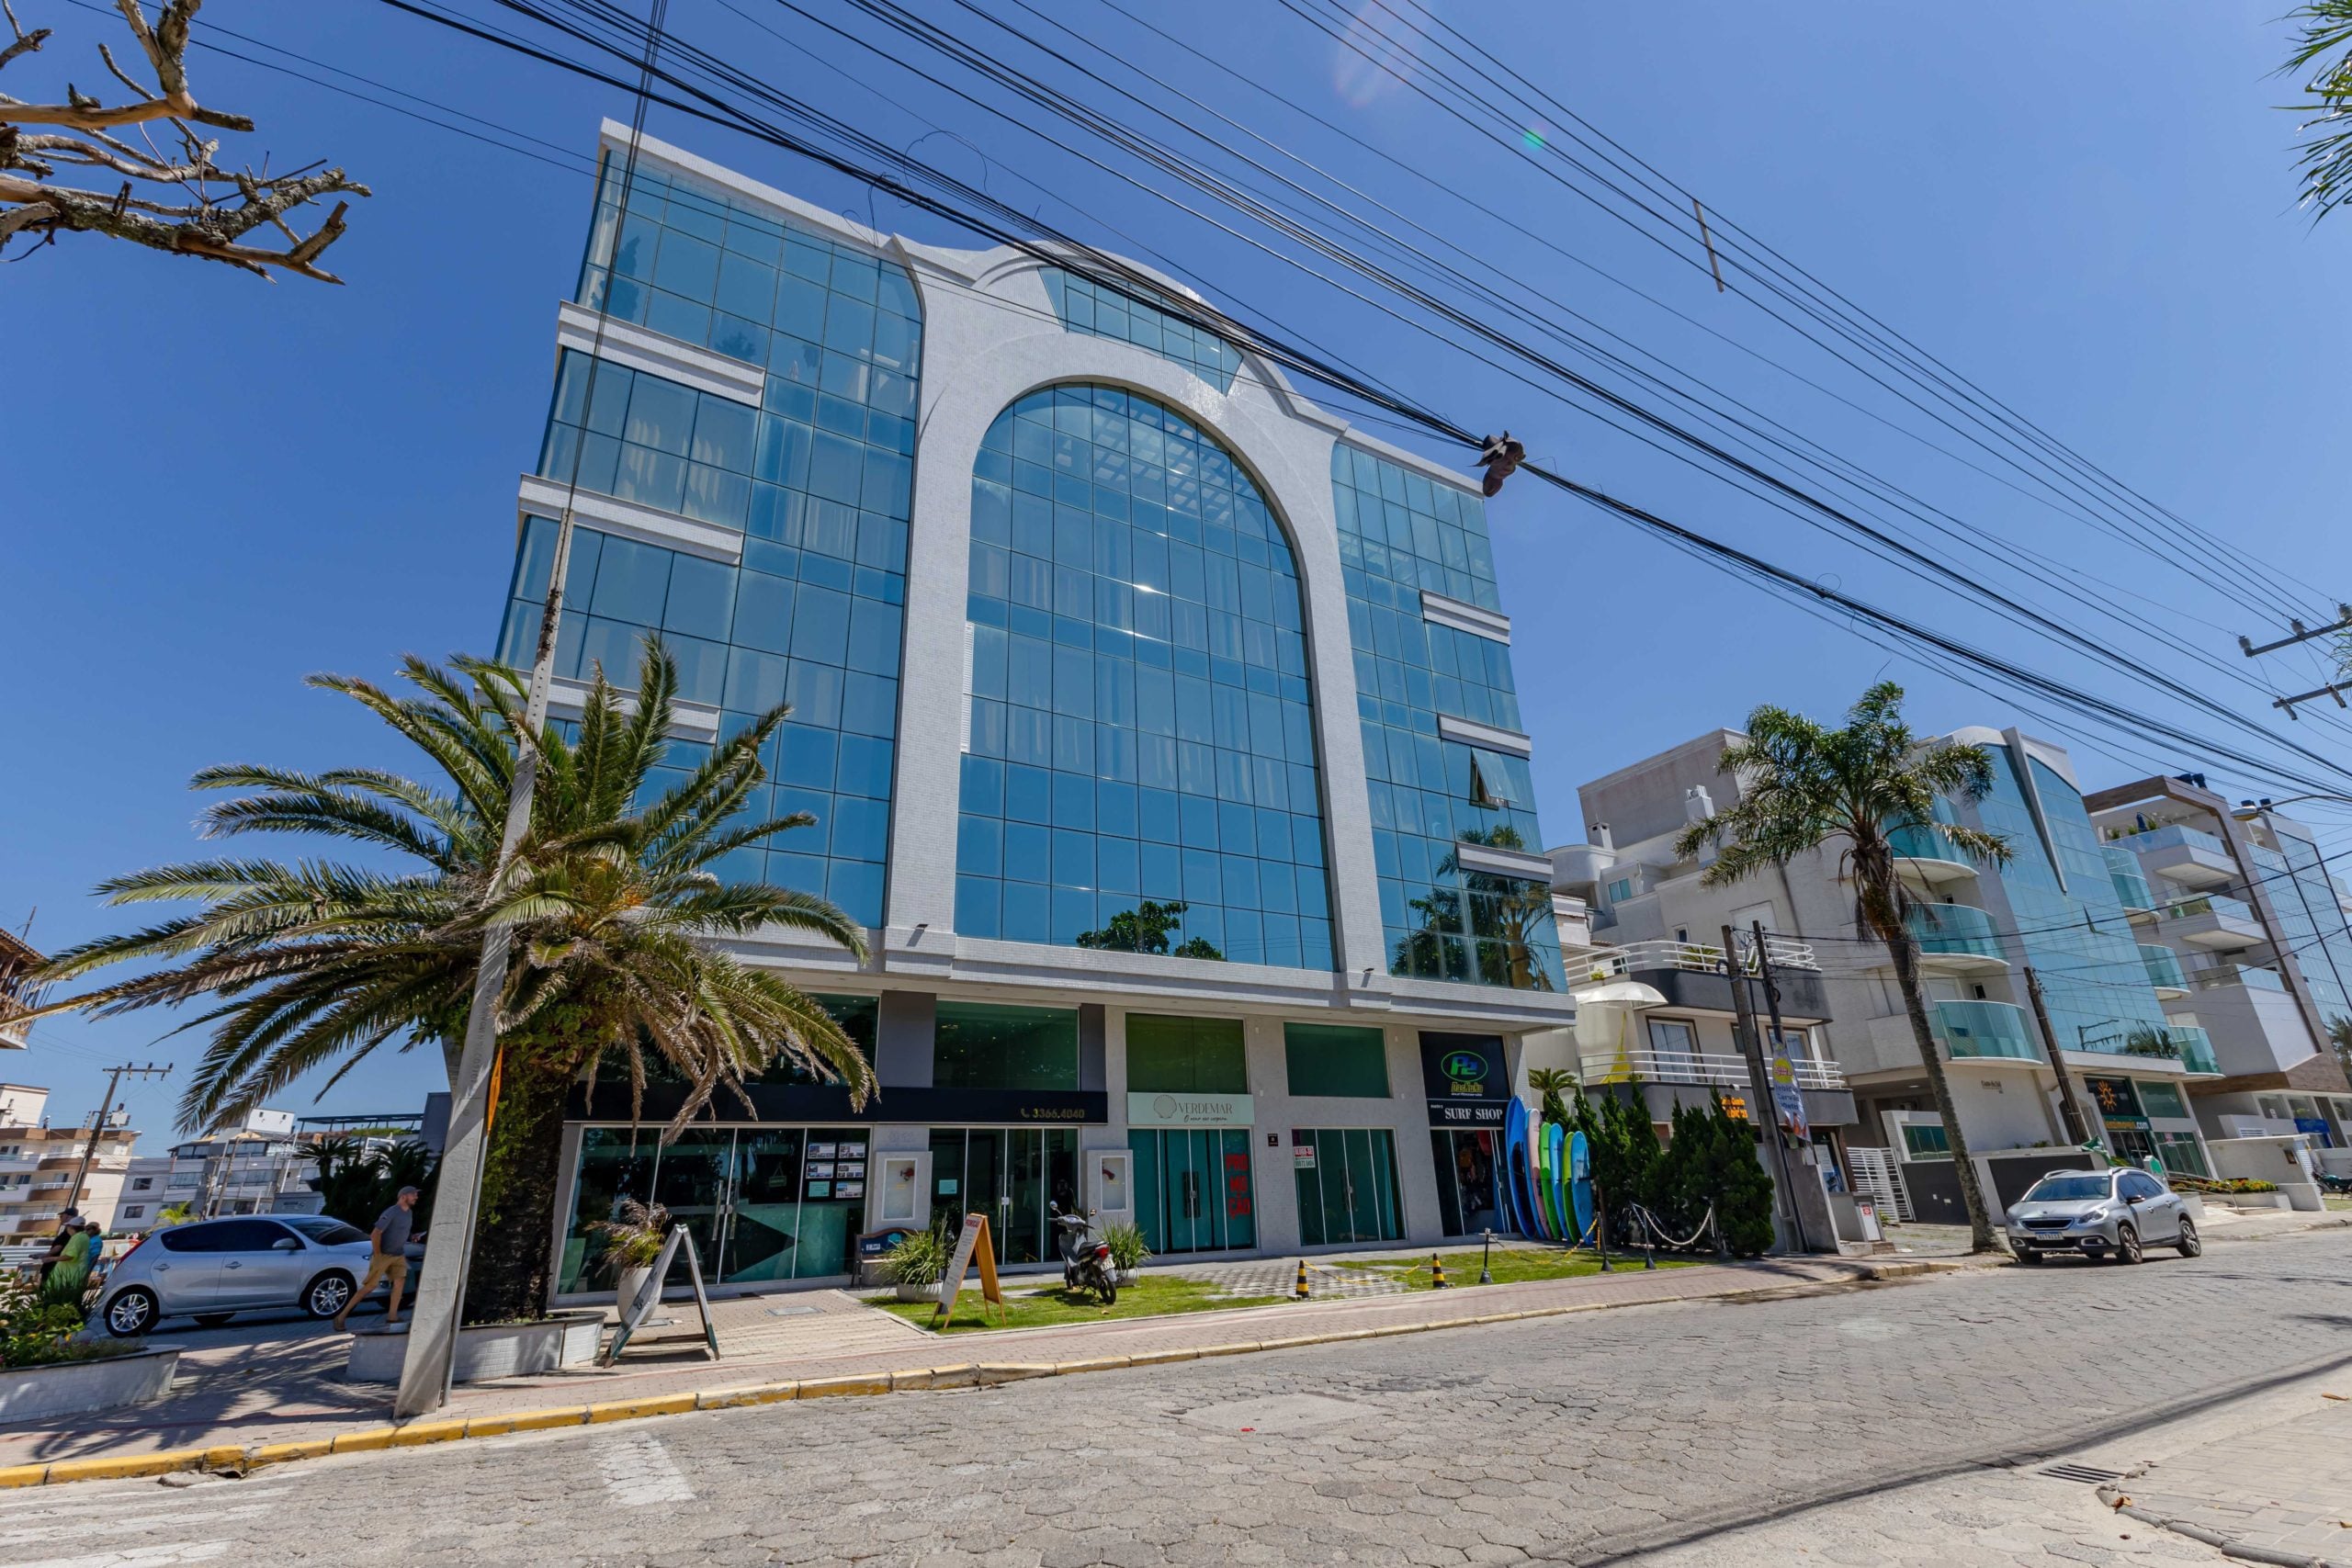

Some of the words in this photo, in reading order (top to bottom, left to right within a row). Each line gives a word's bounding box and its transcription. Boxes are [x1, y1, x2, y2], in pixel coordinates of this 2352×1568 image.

[1032, 1108, 1085, 1119] 3366.4040
[1178, 1102, 1233, 1114] VERDEMAR
[1444, 1107, 1472, 1120] SURF
[1476, 1108, 1503, 1120] SHOP
[1226, 1153, 1249, 1170] PRO
[1229, 1175, 1248, 1192] MO
[1228, 1193, 1250, 1220] ÇÃO
